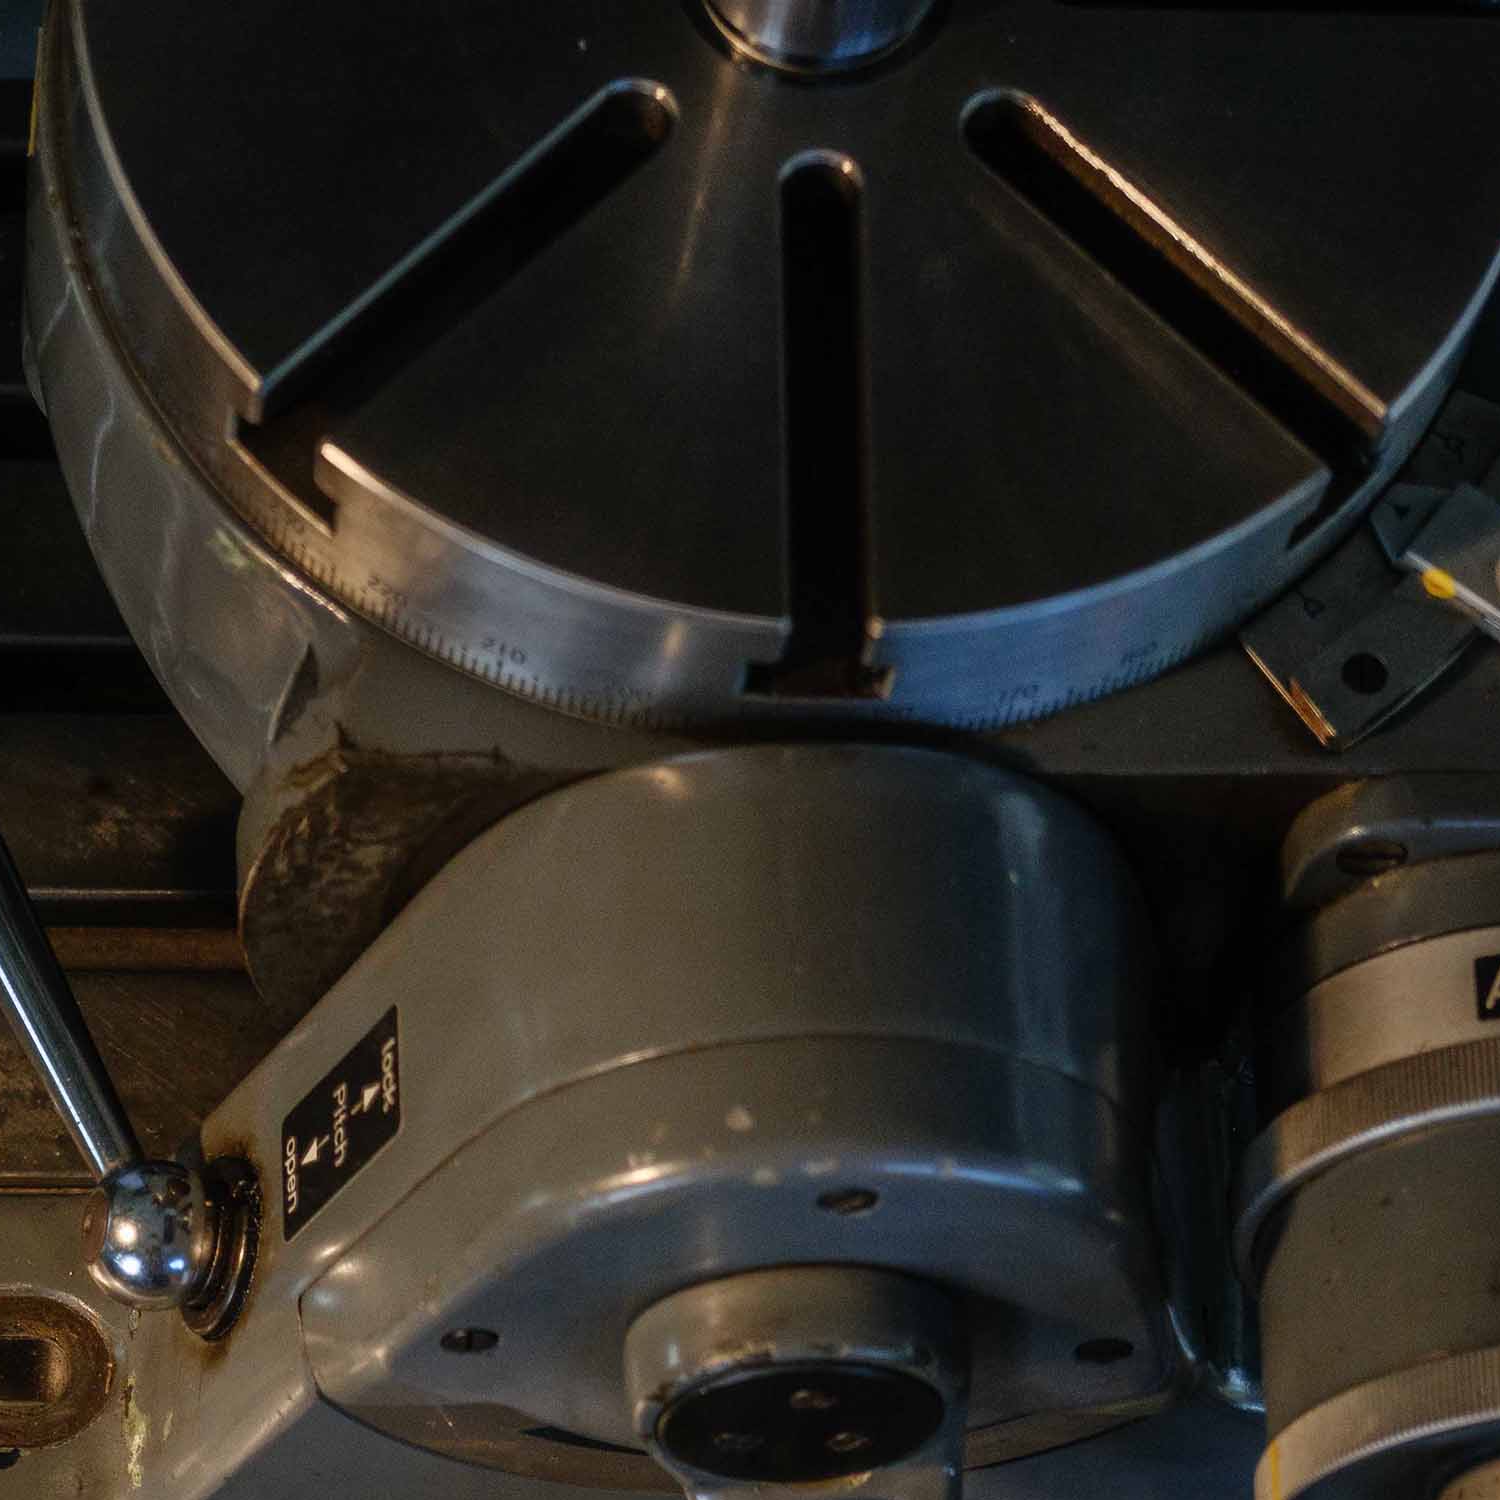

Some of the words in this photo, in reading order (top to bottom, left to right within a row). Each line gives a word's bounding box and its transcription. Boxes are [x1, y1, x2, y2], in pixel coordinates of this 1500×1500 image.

[381, 1037, 397, 1113] lock
[332, 1081, 348, 1168] Pitch
[284, 1136, 299, 1214] open
